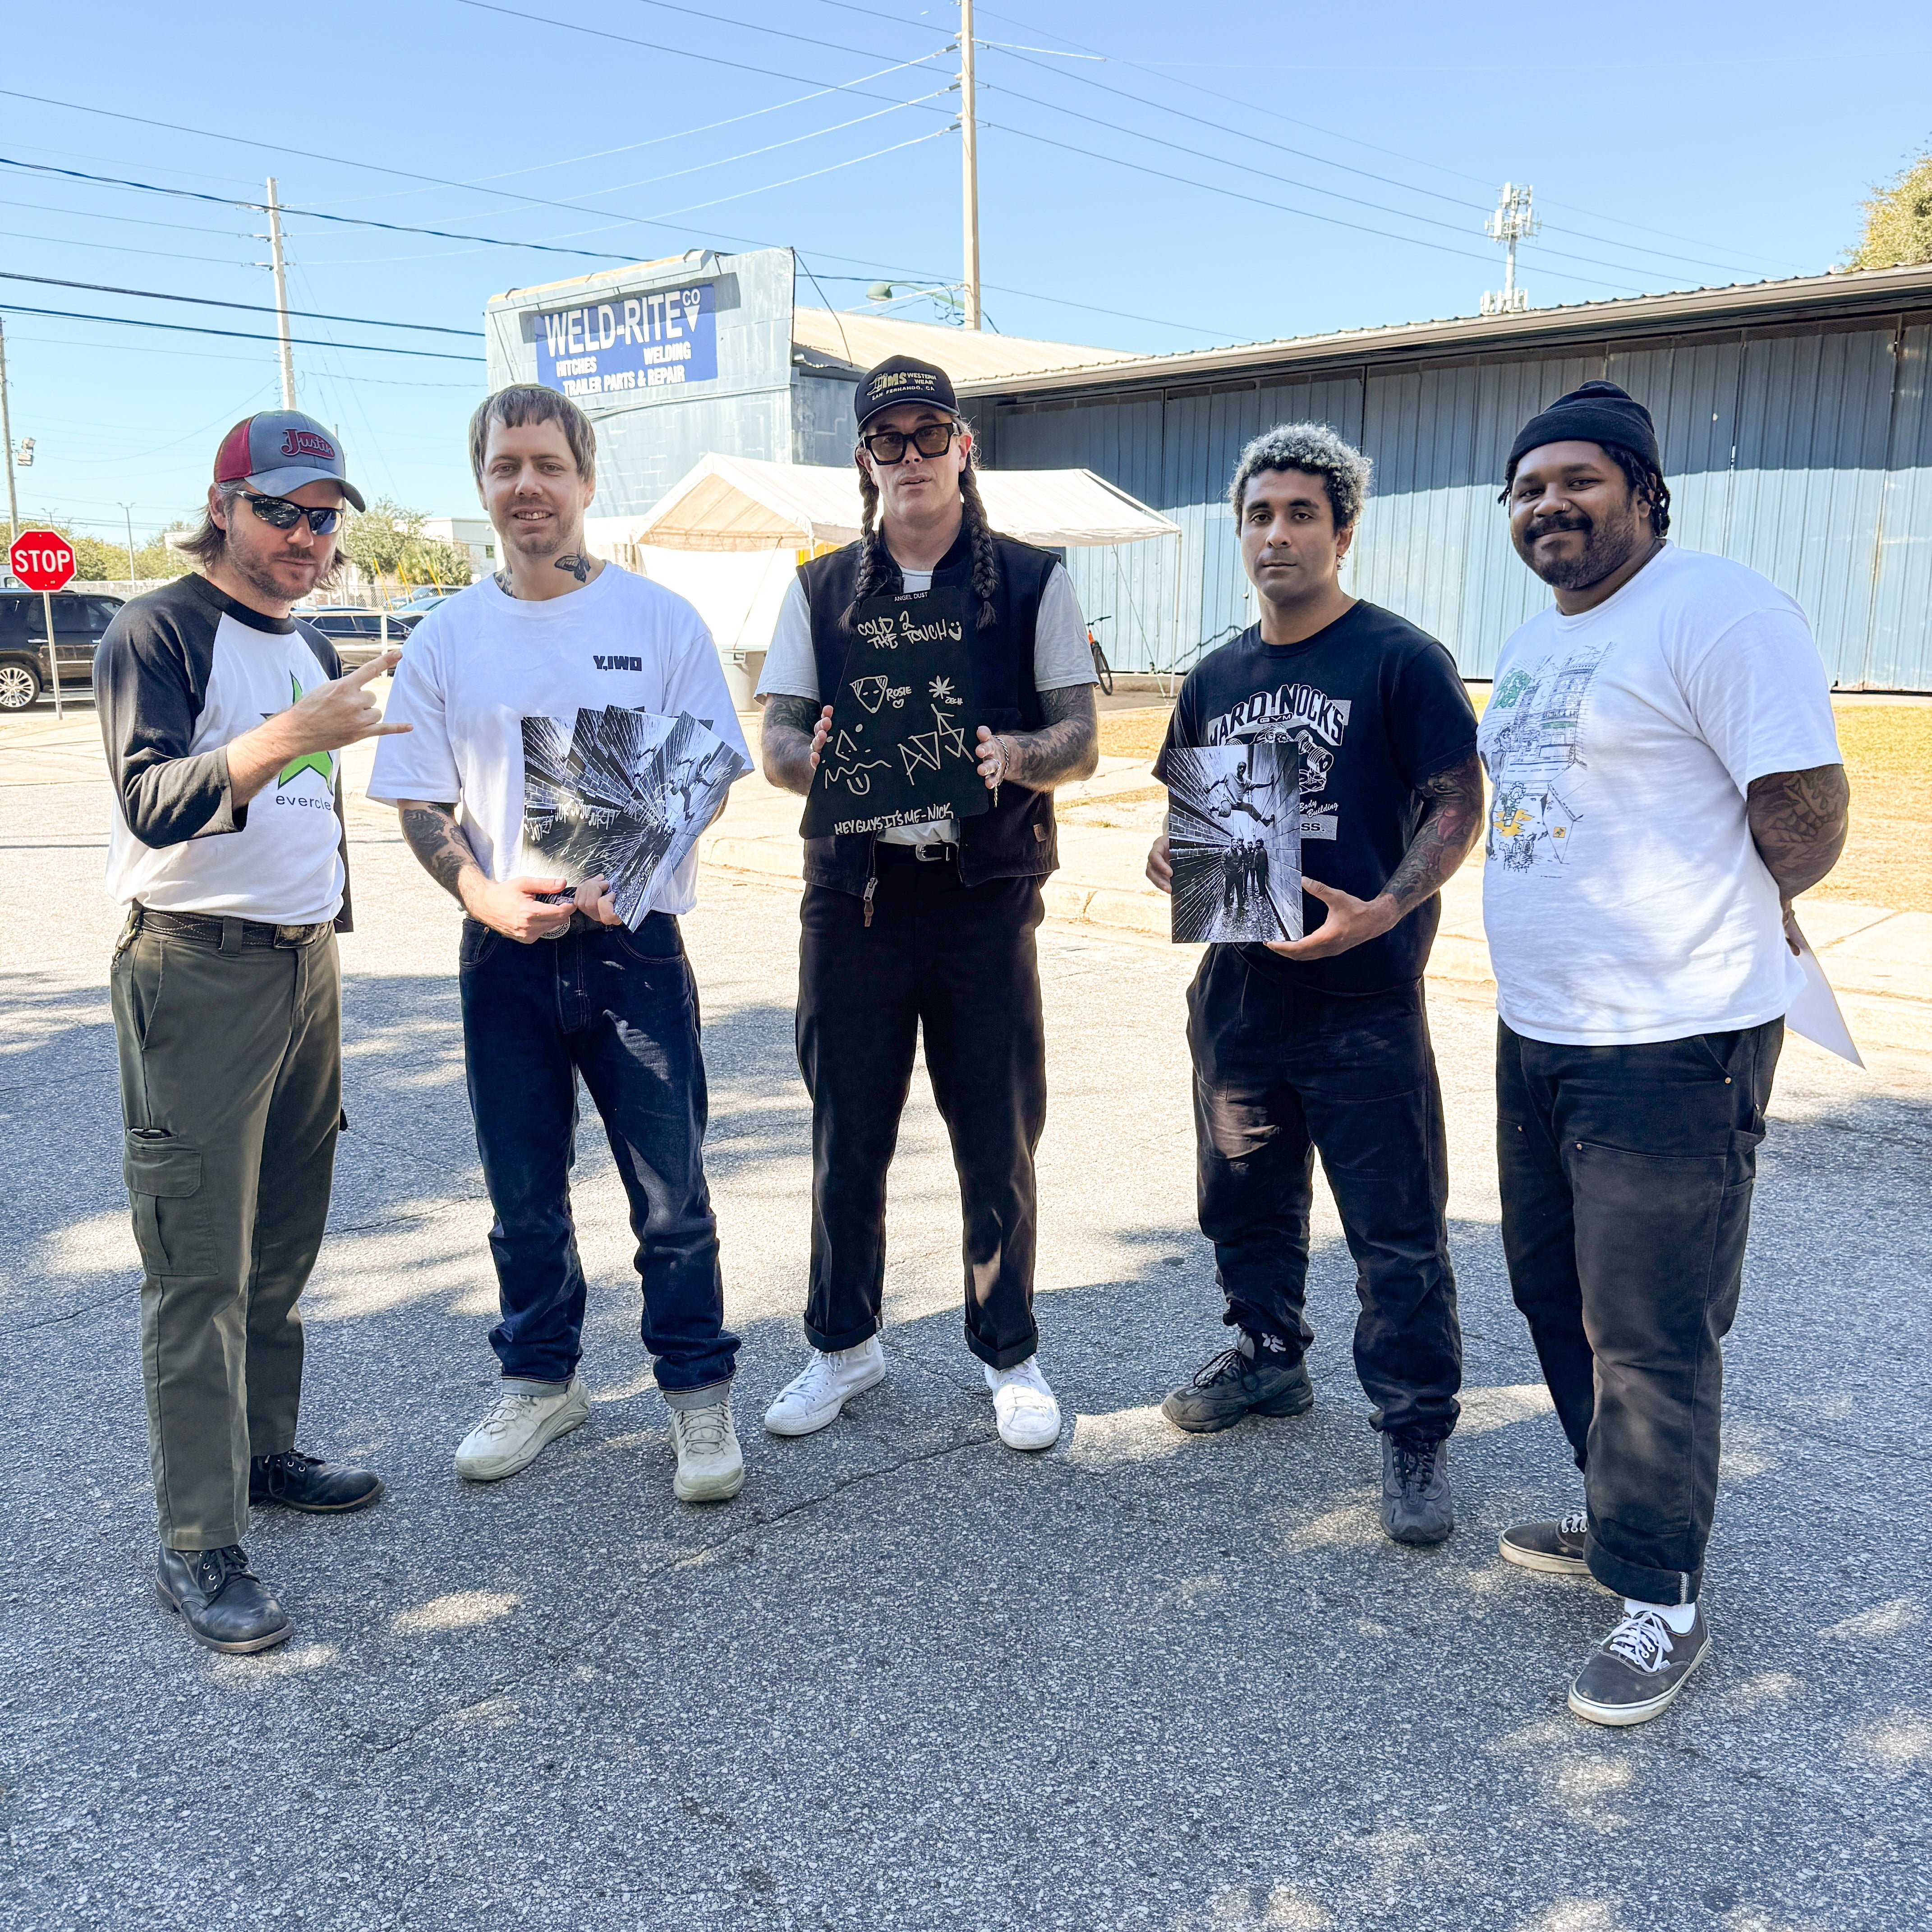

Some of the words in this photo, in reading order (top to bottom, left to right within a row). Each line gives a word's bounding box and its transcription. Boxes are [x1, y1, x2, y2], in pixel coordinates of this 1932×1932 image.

[544, 291, 683, 357] WELD-RITE
[682, 289, 700, 306] CO
[643, 342, 691, 365] WELDING
[556, 356, 597, 377] HITCHES
[563, 377, 602, 397] TRAILER
[604, 371, 635, 391] PARTS
[637, 370, 646, 387] &
[647, 365, 685, 386] REPAIR
[907, 372, 937, 380] WESTERN
[872, 392, 883, 400] SAN
[886, 386, 923, 394] FERNANDO,
[280, 428, 333, 456] Justin
[14, 549, 70, 573] STOP
[913, 592, 928, 600] DUST
[857, 616, 893, 636] COLD
[899, 611, 915, 630] 2
[867, 633, 898, 649] THE
[901, 618, 947, 644] TOUCH
[886, 686, 912, 701] ROSIE
[1260, 714, 1292, 723] GYM
[276, 796, 331, 810] evercle
[1299, 800, 1317, 811] Body
[1306, 802, 1339, 818] Building
[834, 819, 855, 835] HEY
[856, 817, 883, 833] GUYS
